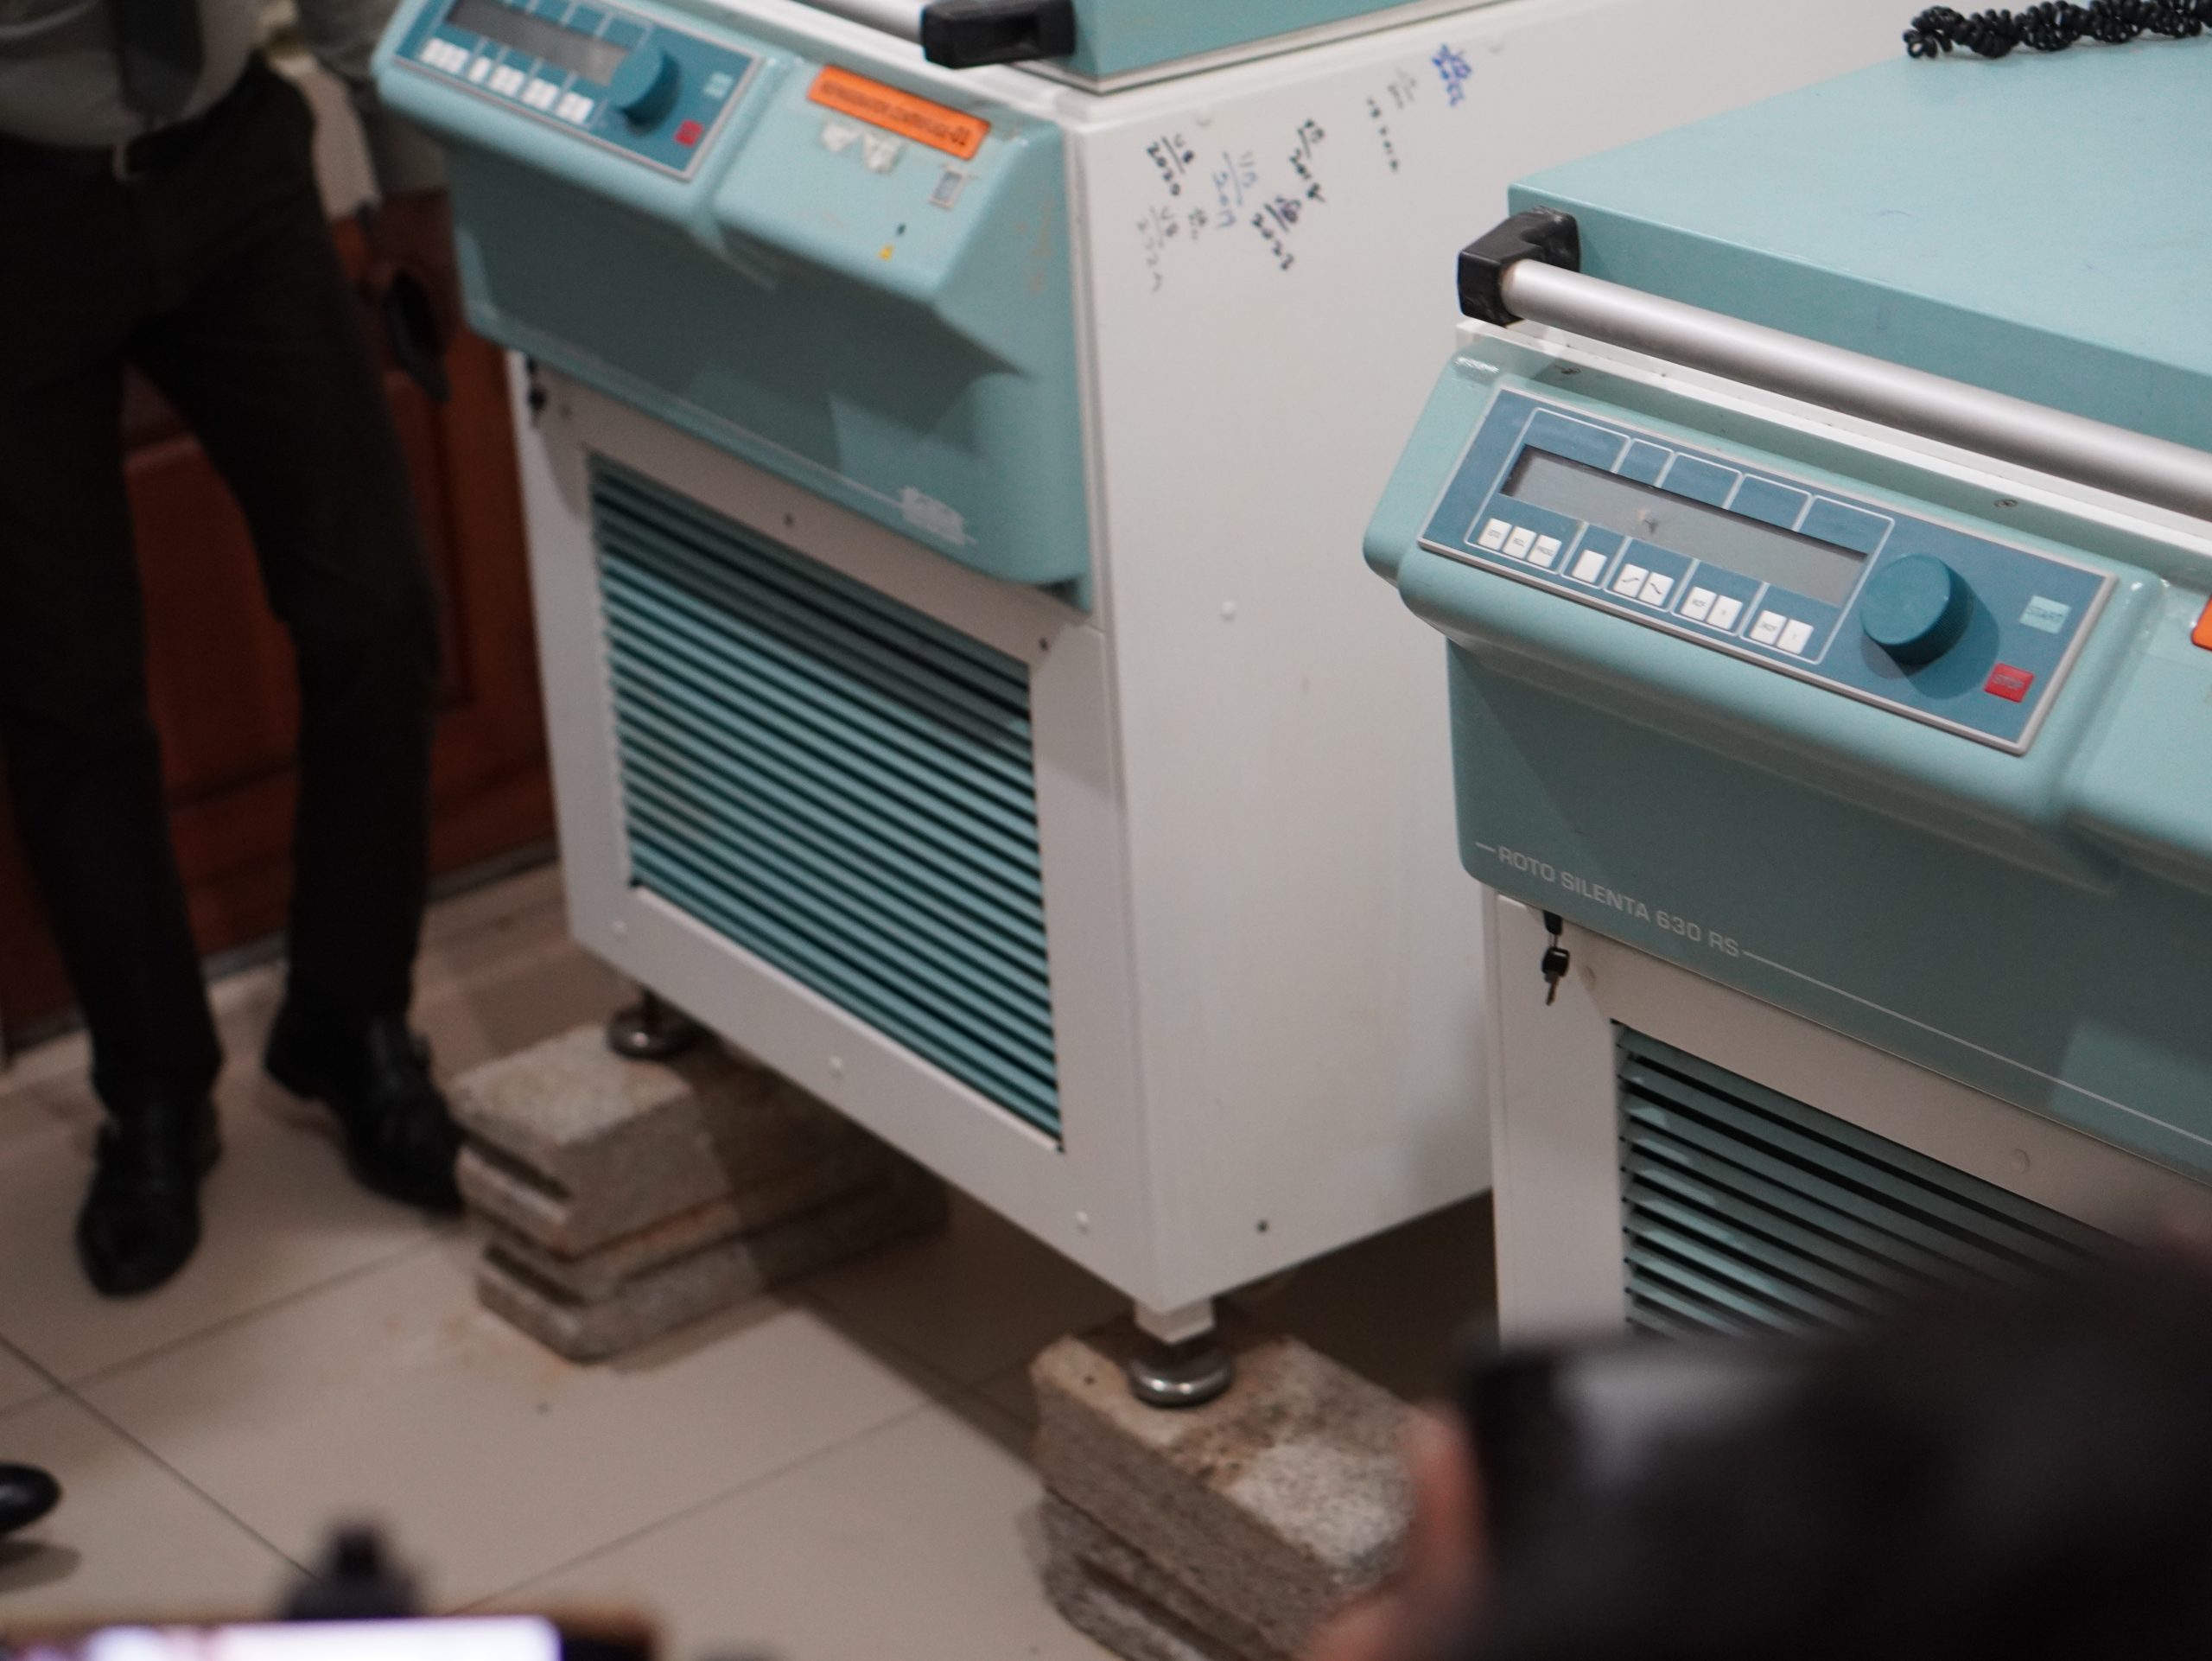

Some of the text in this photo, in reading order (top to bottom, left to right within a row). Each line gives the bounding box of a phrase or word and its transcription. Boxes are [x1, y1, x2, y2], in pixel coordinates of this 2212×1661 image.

[1497, 845, 1740, 958] ROTO SILENTA 630 RS
